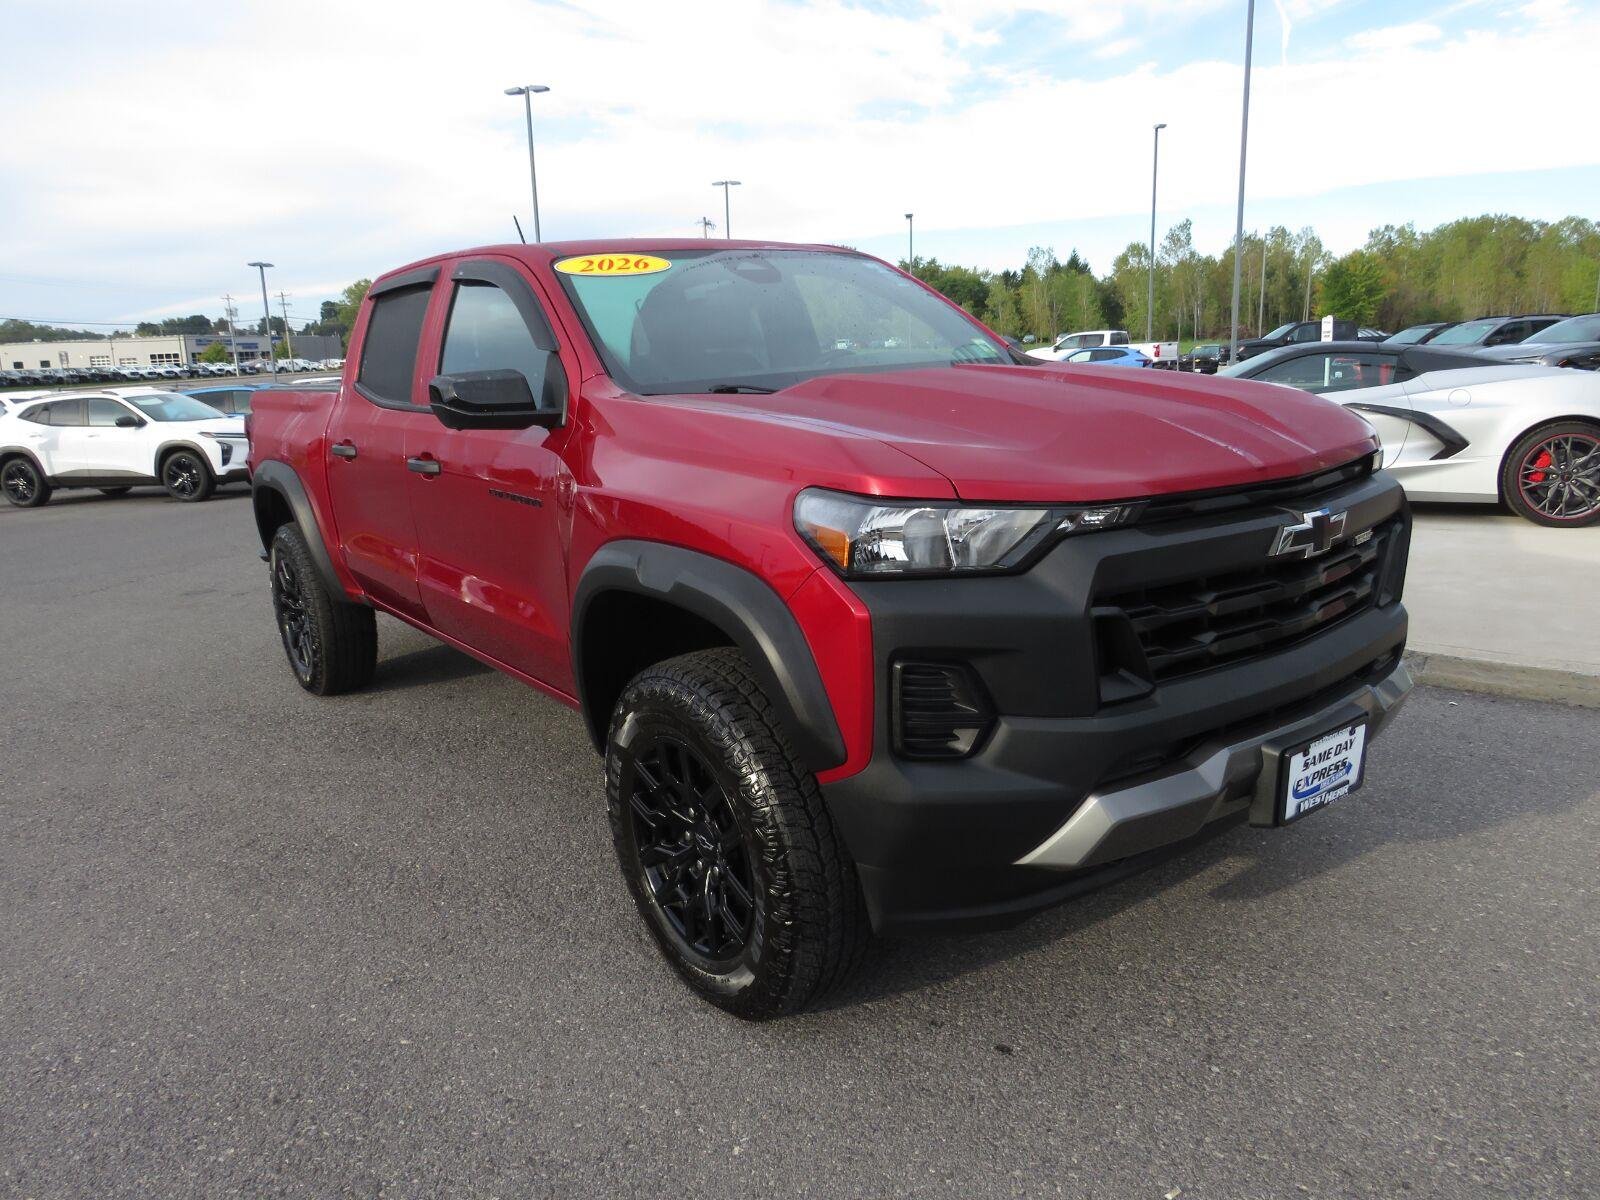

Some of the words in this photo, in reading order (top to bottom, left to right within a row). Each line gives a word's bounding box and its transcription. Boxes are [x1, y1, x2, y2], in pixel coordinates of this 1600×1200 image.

[580, 258, 649, 272] 2026
[1302, 746, 1333, 772] SAME
[1334, 737, 1356, 757] DAY
[1296, 757, 1348, 792] EXPRESS
